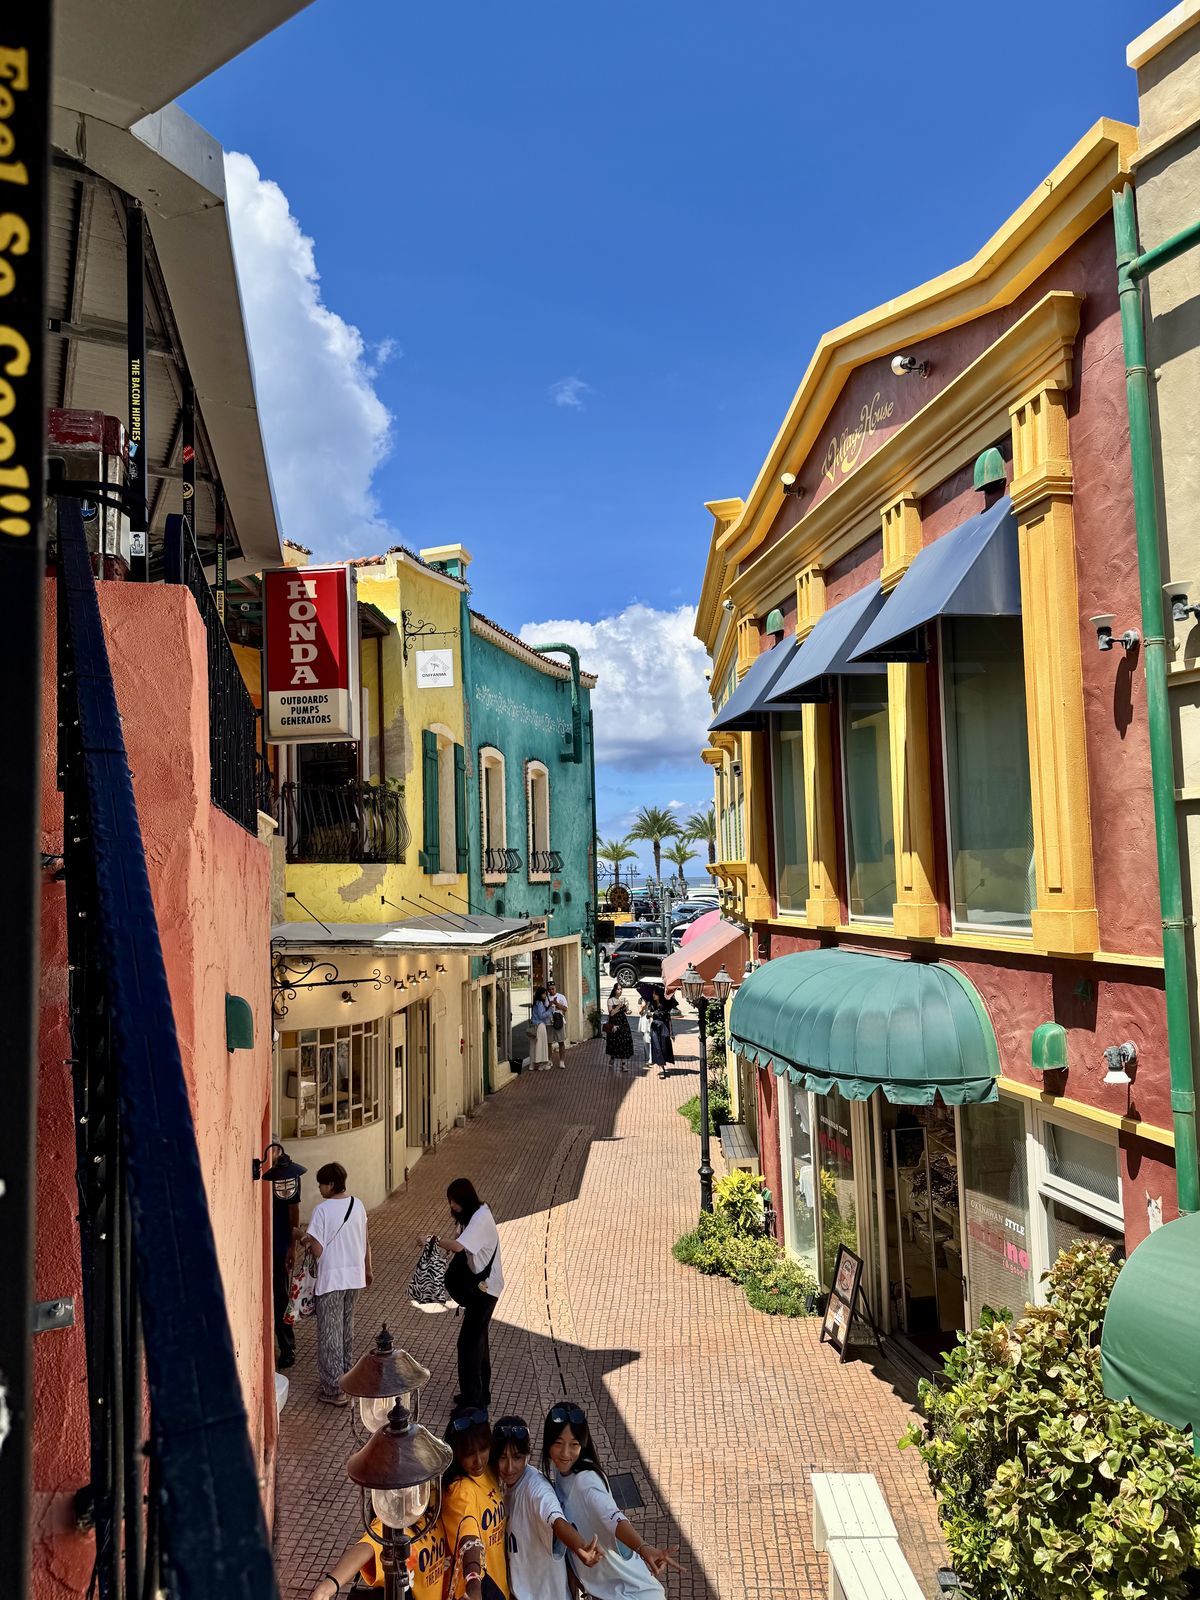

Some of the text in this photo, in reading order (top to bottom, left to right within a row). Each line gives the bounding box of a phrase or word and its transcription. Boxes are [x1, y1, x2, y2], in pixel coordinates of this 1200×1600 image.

[131, 358, 141, 441] THE BACON HIPPIES
[286, 579, 319, 685] HONDA
[280, 694, 329, 706] OUTBOARDS
[290, 705, 320, 715] PUMPS
[280, 714, 332, 726] GENERATORS
[1004, 1217, 1026, 1236] STYLE
